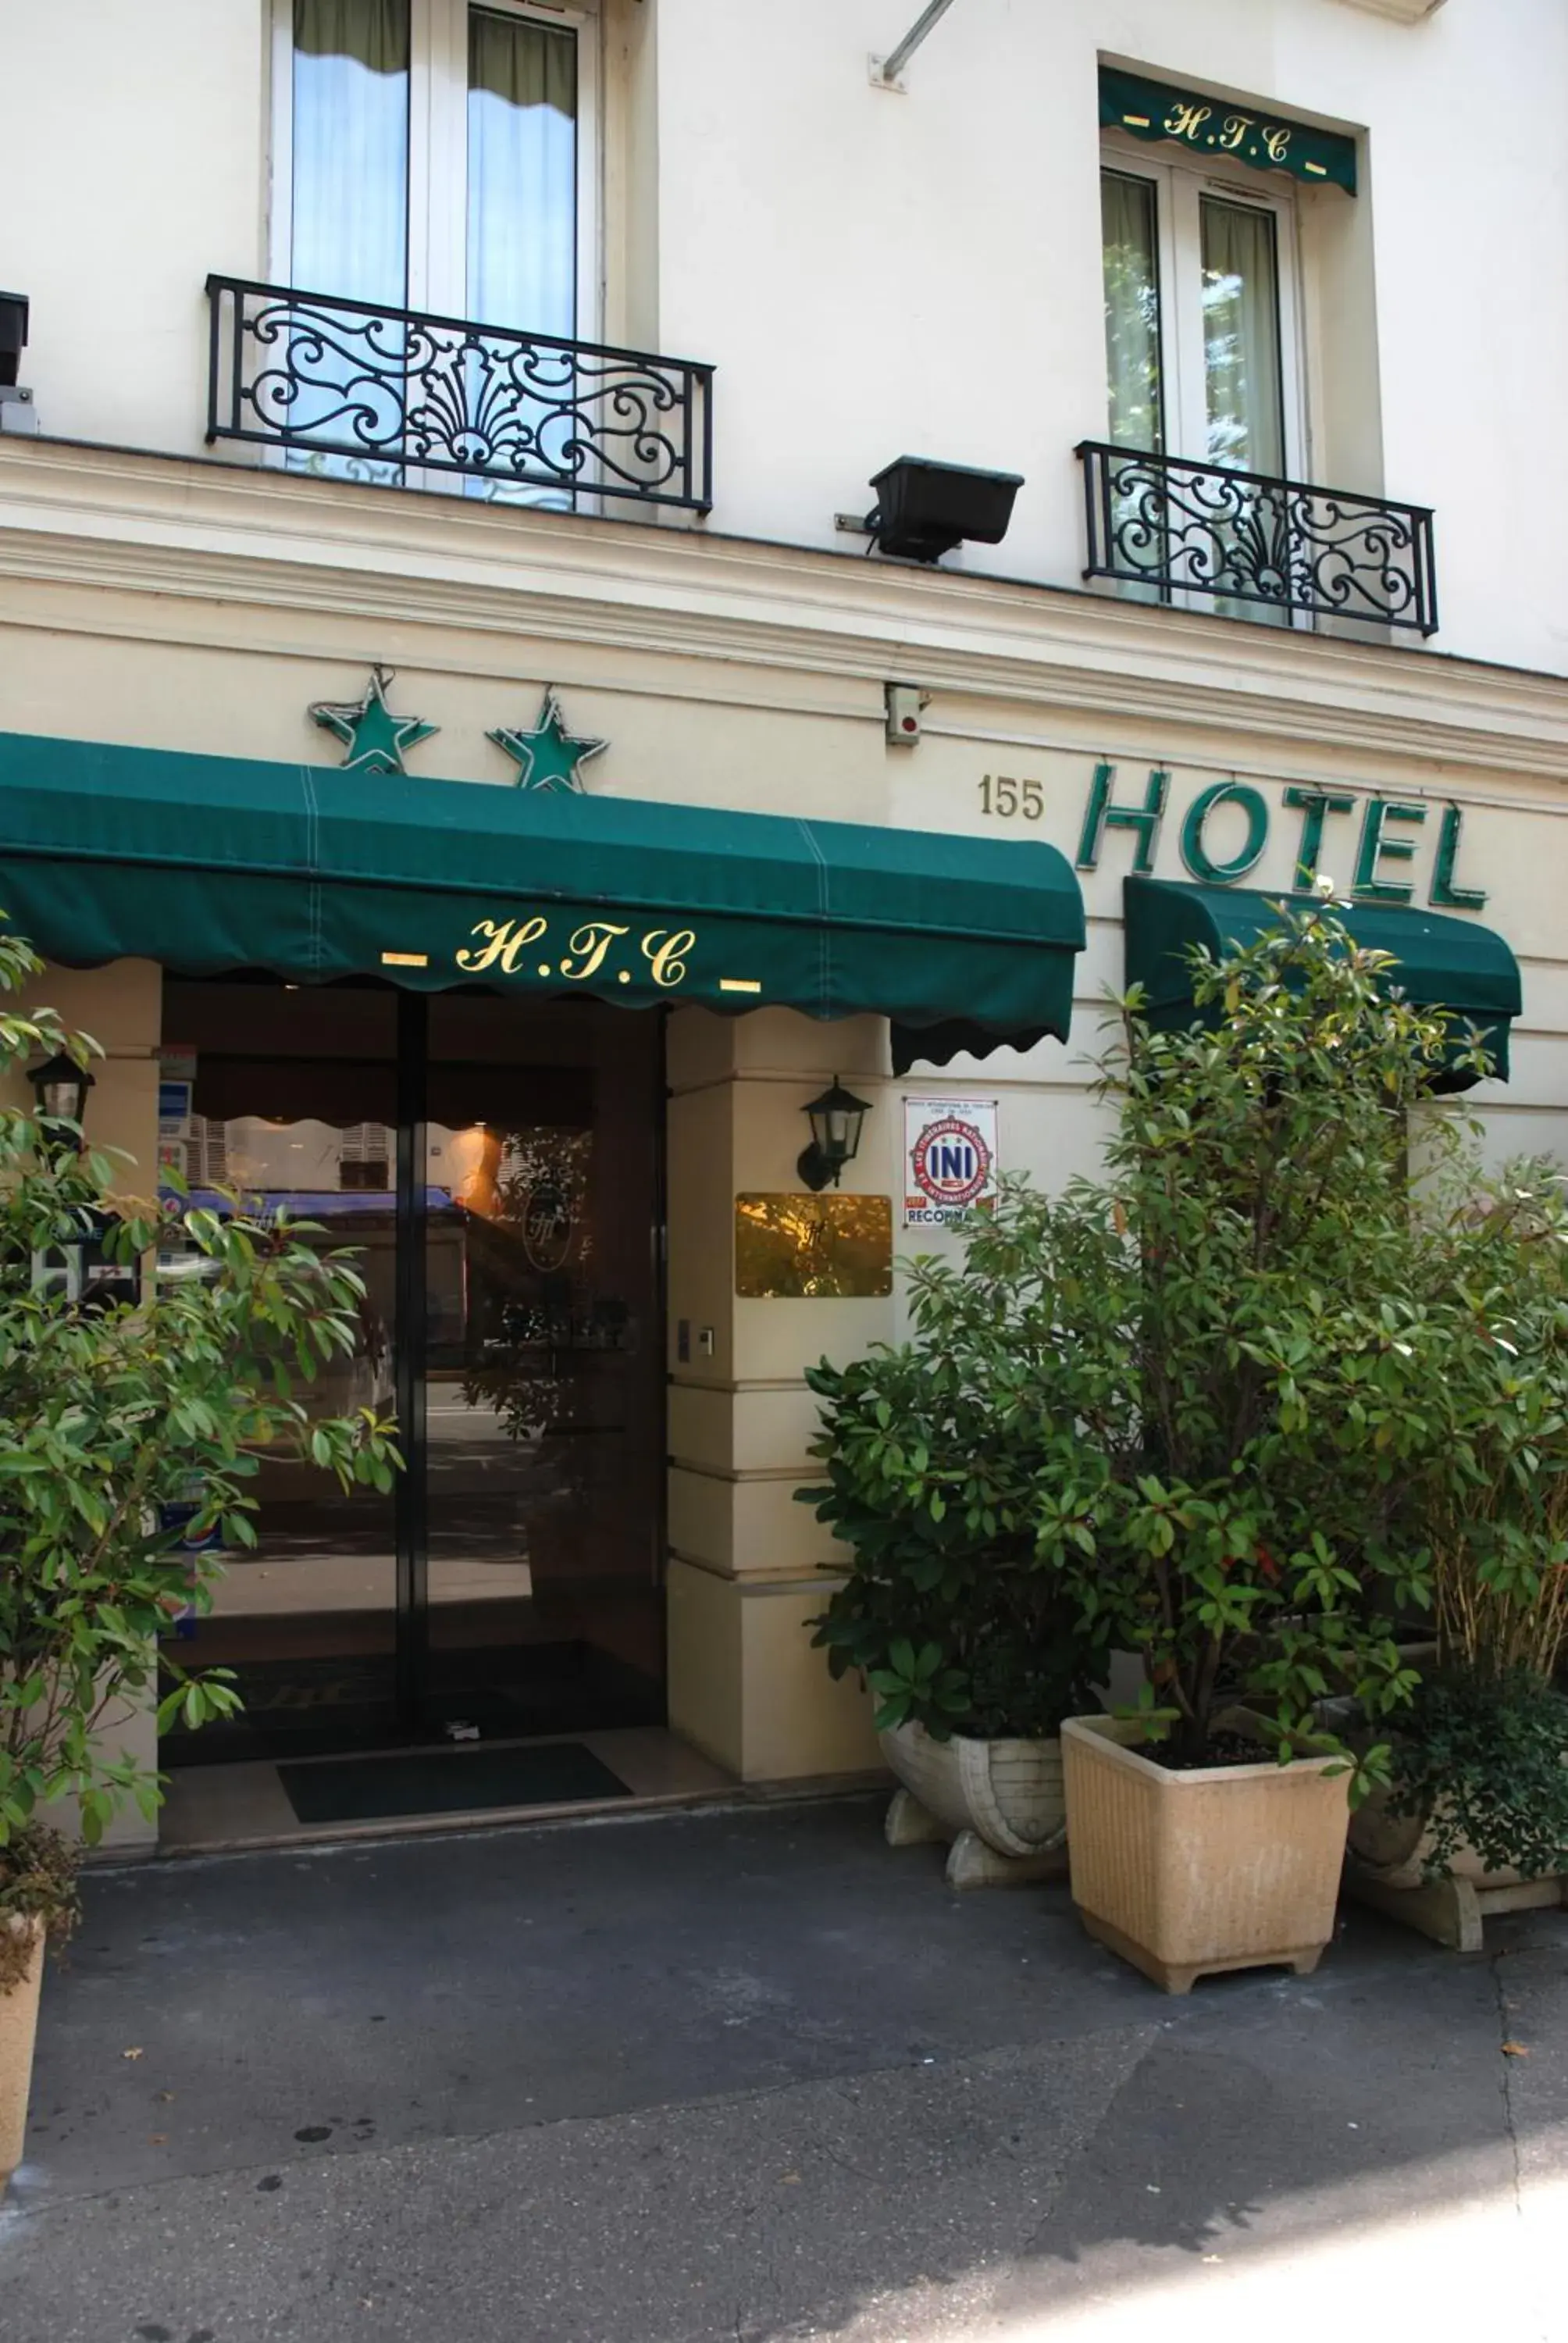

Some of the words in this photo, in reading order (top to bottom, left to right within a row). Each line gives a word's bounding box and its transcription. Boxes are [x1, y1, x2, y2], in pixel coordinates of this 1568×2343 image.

[978, 774, 1044, 819] 155
[1076, 764, 1487, 909] HOTEL
[931, 1146, 972, 1179] INI
